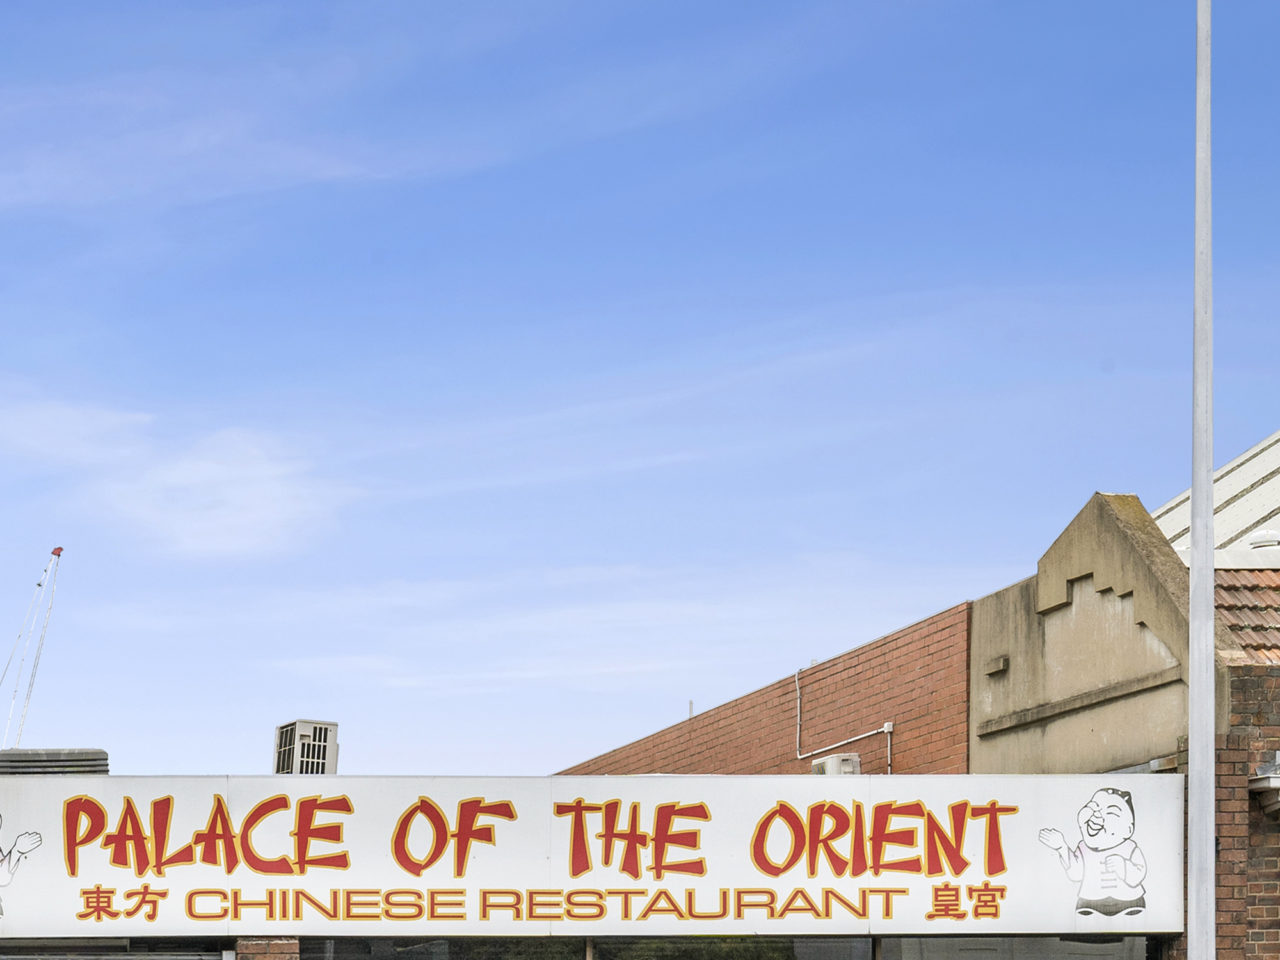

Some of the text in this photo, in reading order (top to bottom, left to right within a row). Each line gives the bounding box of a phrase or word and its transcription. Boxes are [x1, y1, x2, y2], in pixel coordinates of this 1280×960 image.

[63, 794, 1019, 881] PALACE OF THE ORIENT
[76, 882, 169, 922] 東方
[184, 887, 910, 922] CHINESE RESTAURANT
[925, 881, 1007, 920] 皇宮
